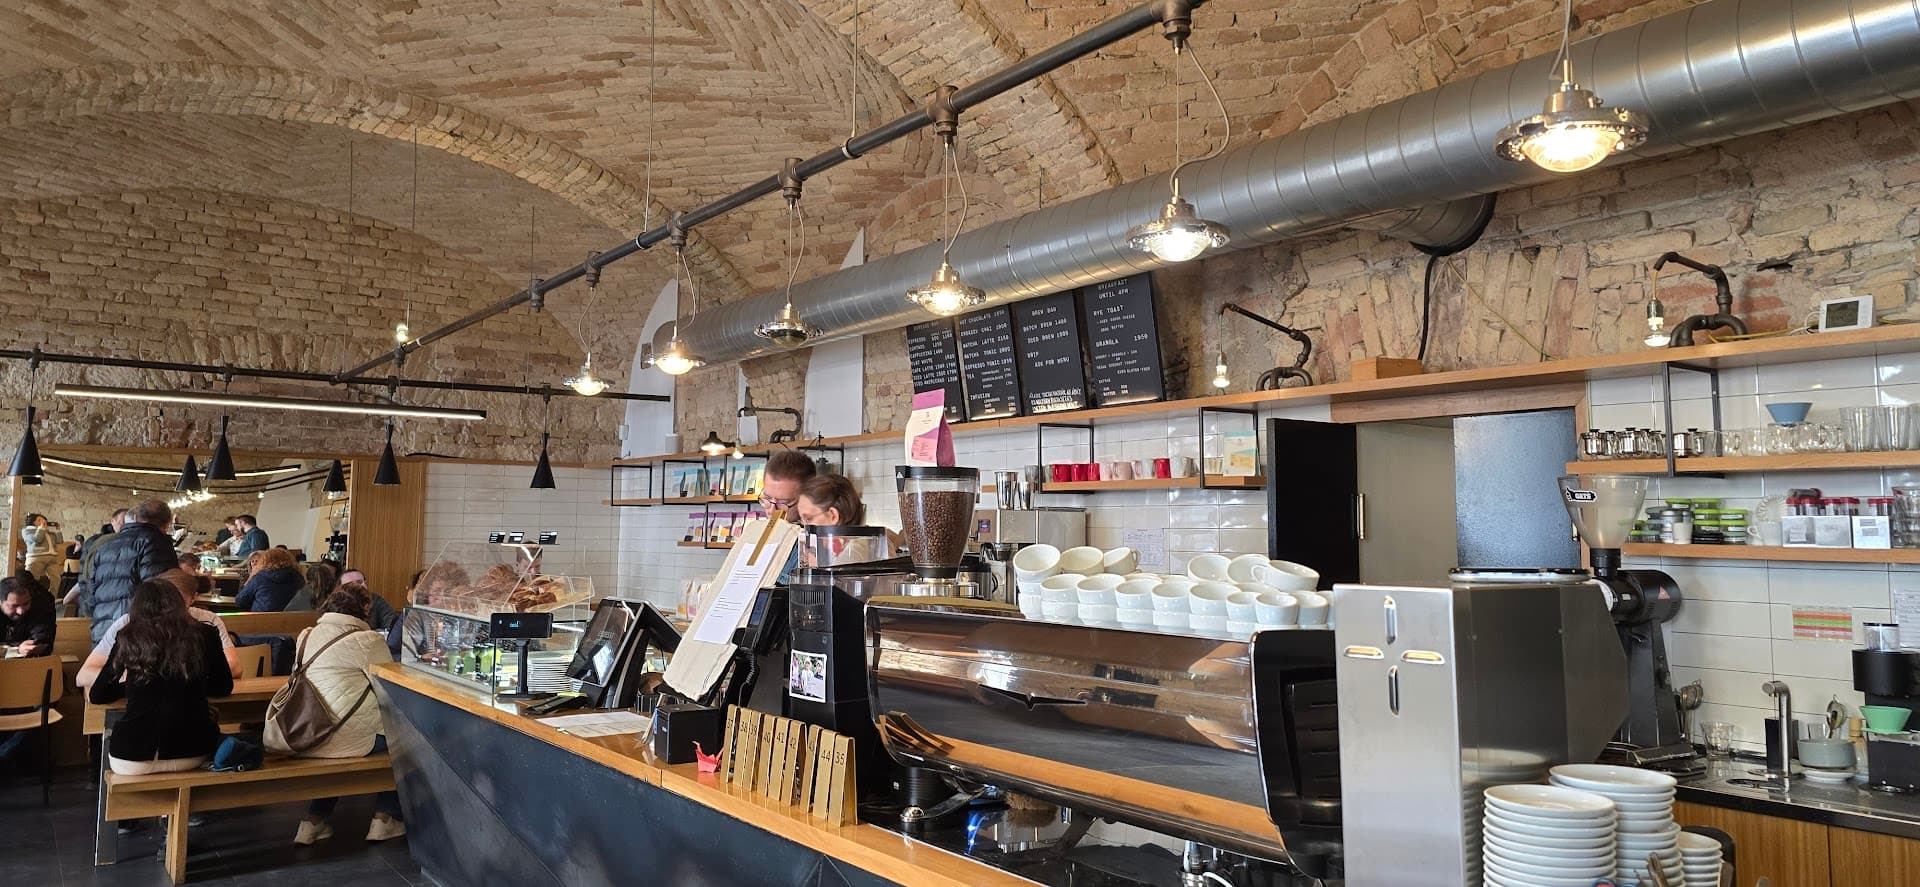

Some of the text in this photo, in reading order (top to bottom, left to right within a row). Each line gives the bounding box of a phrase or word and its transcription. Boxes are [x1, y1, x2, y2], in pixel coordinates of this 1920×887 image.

[1098, 279, 1128, 290] BREAKFAST
[1099, 288, 1128, 300] UNTIL 4PM
[1094, 305, 1123, 316] RYE TOAST
[1041, 321, 1052, 329] BREW
[982, 337, 994, 345] LATTE
[1042, 333, 1054, 341] BREW
[1096, 338, 1119, 348] GRANOLA
[984, 348, 997, 356] TONIC
[1057, 356, 1070, 364] MENU
[970, 393, 991, 401] INFUSION
[727, 718, 733, 728] 37
[740, 721, 748, 733] 38
[750, 724, 757, 735] 39
[763, 732, 771, 744] 40
[777, 732, 784, 744] 41
[790, 737, 796, 749] 42
[821, 750, 831, 762] 44
[835, 751, 845, 765] 35
